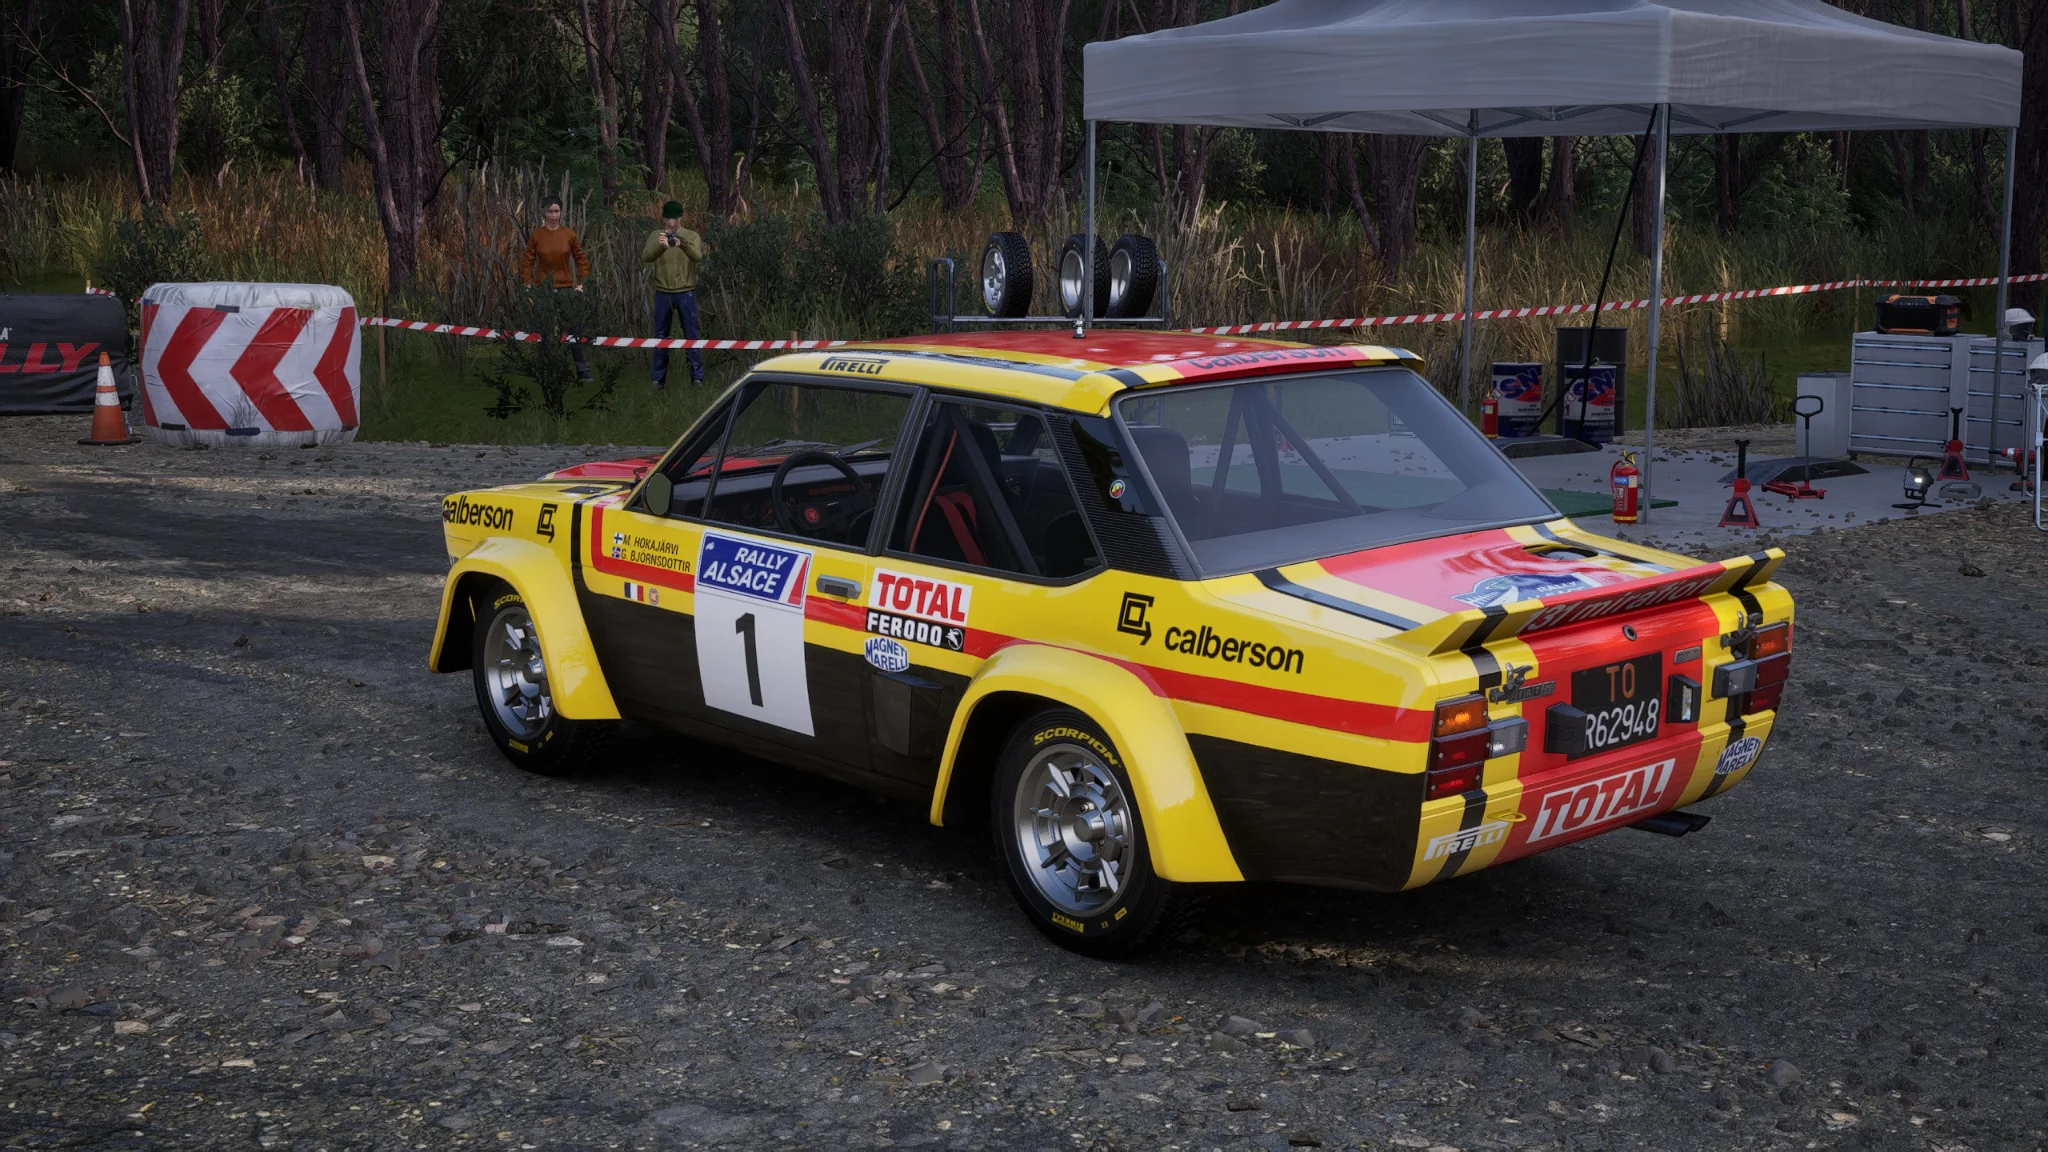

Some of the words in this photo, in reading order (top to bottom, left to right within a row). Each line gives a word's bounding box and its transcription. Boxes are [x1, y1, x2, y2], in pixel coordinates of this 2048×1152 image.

[0, 343, 101, 372] LLY
[819, 357, 891, 374] PIRELLI
[621, 549, 629, 559] G.
[630, 550, 691, 572] BJÖRNSDOTTIR
[622, 534, 632, 547] M.
[634, 537, 679, 555] HOKAJÄRVI
[734, 547, 789, 570] RALLY
[703, 561, 781, 594] ALSACE
[878, 573, 966, 622] TOTAL
[867, 612, 943, 647] FERODO
[1515, 601, 1583, 634] 131
[735, 612, 764, 707] 1
[1165, 625, 1304, 674] calberson
[1606, 663, 1636, 702] TO
[1585, 698, 1660, 749] R62948
[1033, 728, 1119, 765] SCORPION
[1538, 763, 1664, 838] TOTAL
[1423, 821, 1509, 862] PIRELLI
